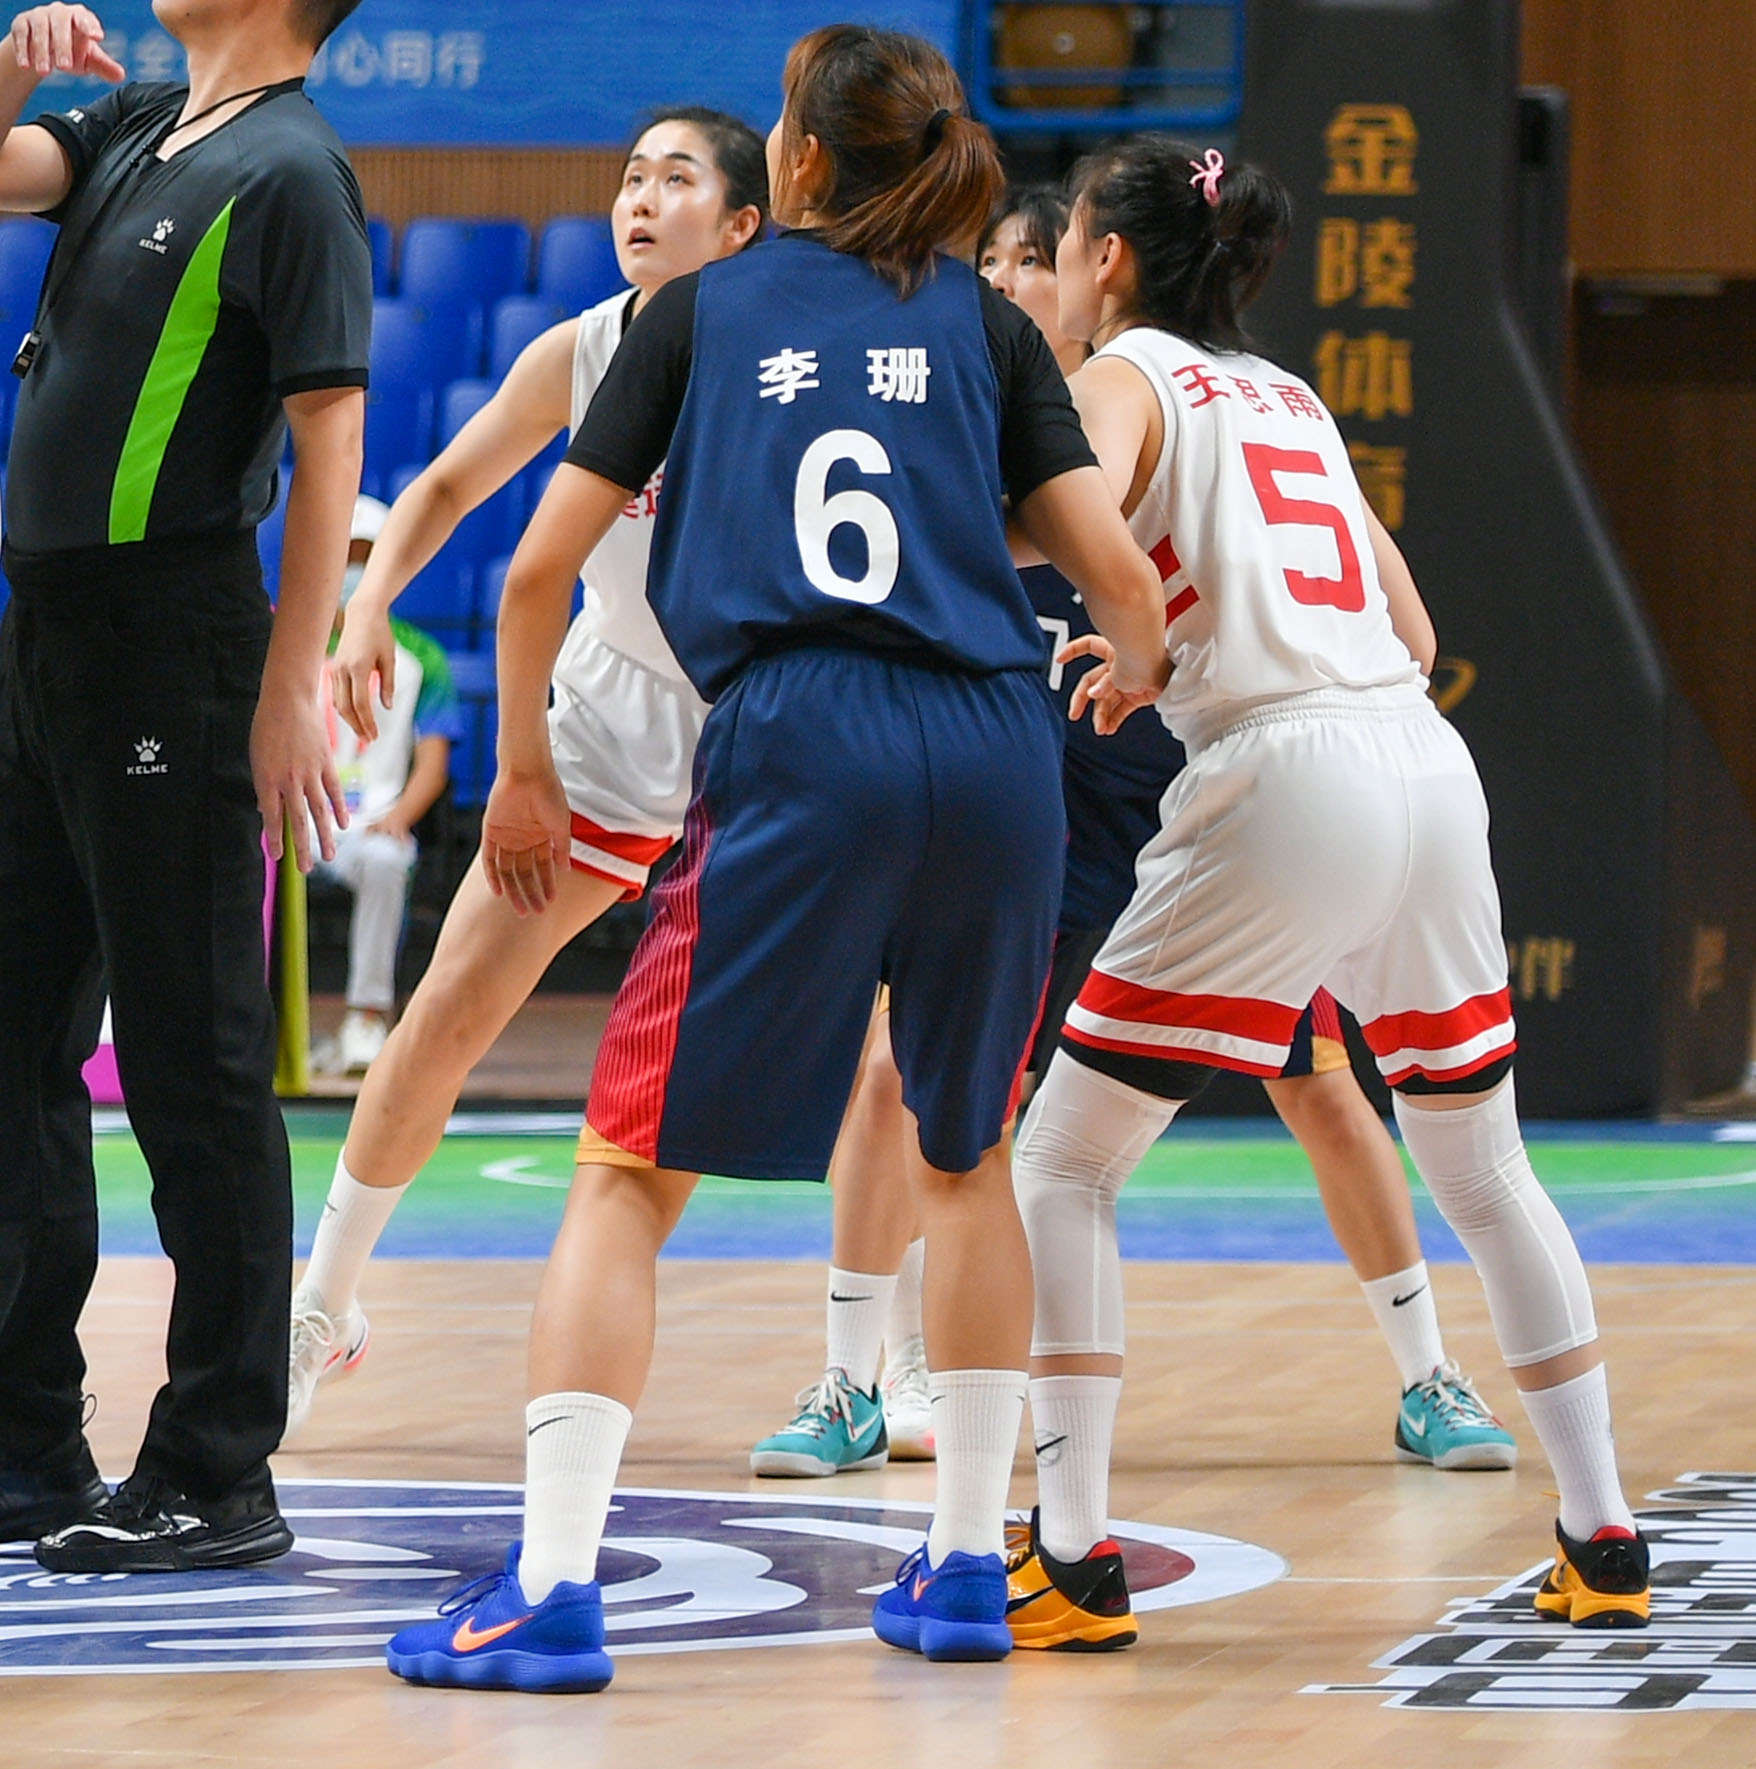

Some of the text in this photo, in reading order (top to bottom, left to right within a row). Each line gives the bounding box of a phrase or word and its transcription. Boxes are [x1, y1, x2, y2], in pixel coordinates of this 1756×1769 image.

[314, 32, 484, 89] 心同行
[757, 348, 931, 404] 李珊
[793, 428, 901, 605] 6
[1240, 441, 1366, 613] 5
[126, 763, 169, 775] KELME
